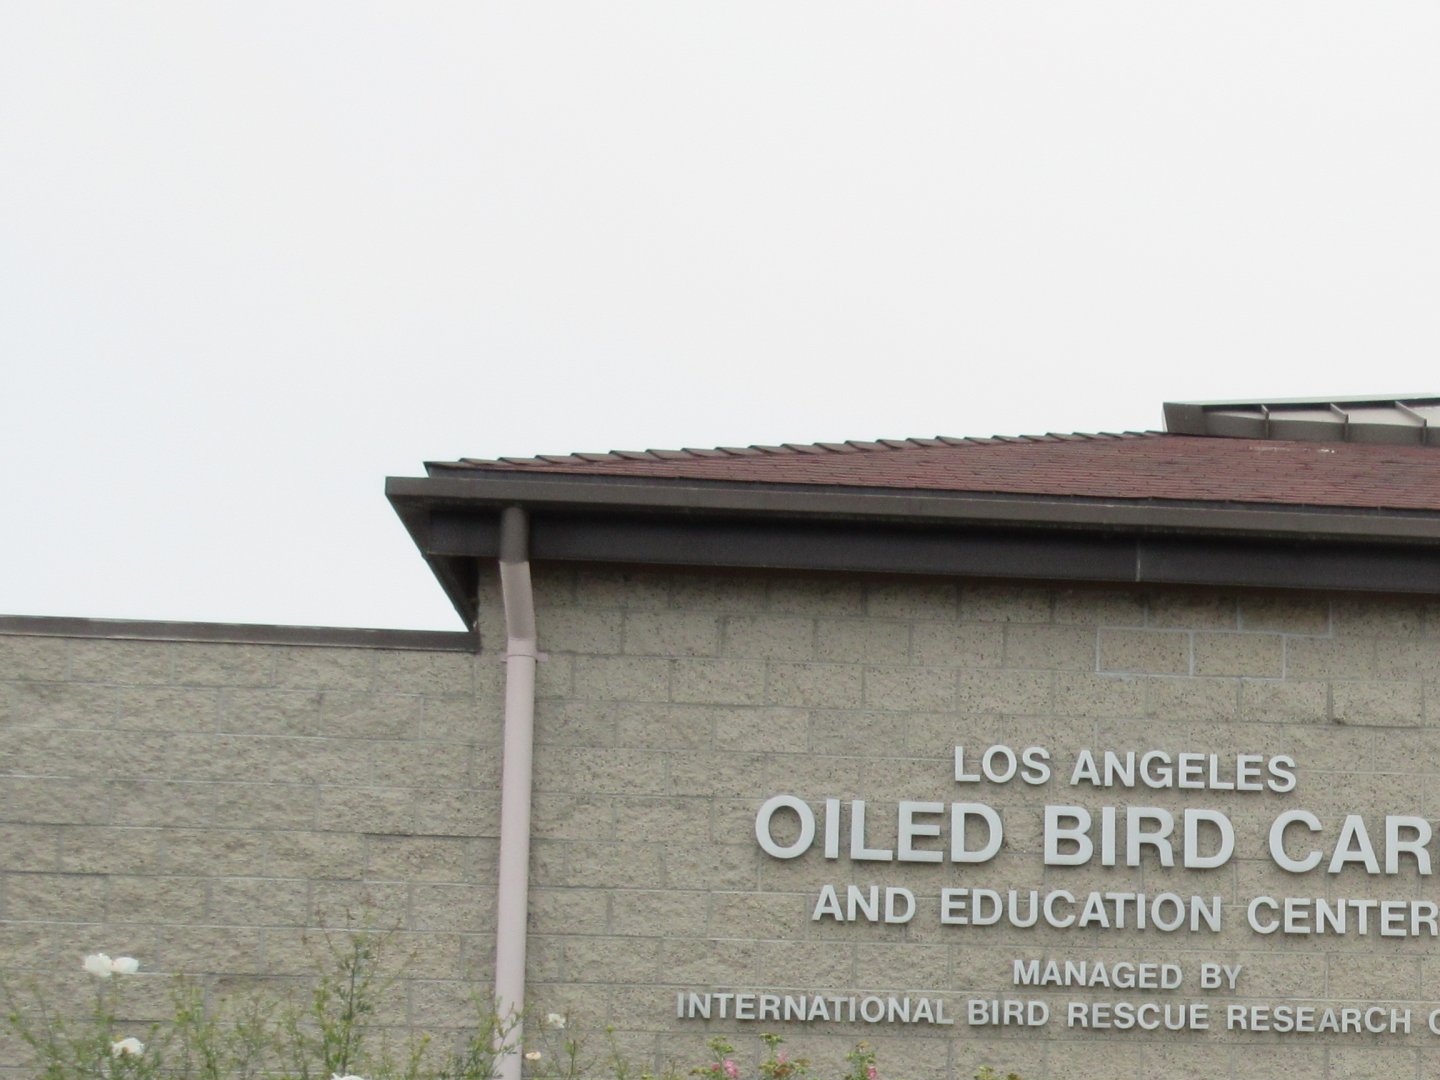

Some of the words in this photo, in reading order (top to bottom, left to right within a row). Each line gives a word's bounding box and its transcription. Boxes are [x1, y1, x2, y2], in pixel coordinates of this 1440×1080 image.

[954, 744, 1051, 786] LOS
[1070, 750, 1296, 792] ANGELES
[755, 794, 1005, 864] OILED
[1043, 804, 1236, 869] BIRD
[811, 883, 917, 925] AND
[941, 888, 1222, 931] EDUCATION
[1247, 896, 1439, 936] CENTER
[1013, 957, 1182, 990] MANAGED
[1201, 962, 1242, 991] BY
[677, 992, 953, 1025] INTERNATIONAL
[968, 999, 1049, 1028] BIRD
[1067, 1000, 1209, 1032] RESCUE
[1227, 1003, 1413, 1035] RESEARCH
